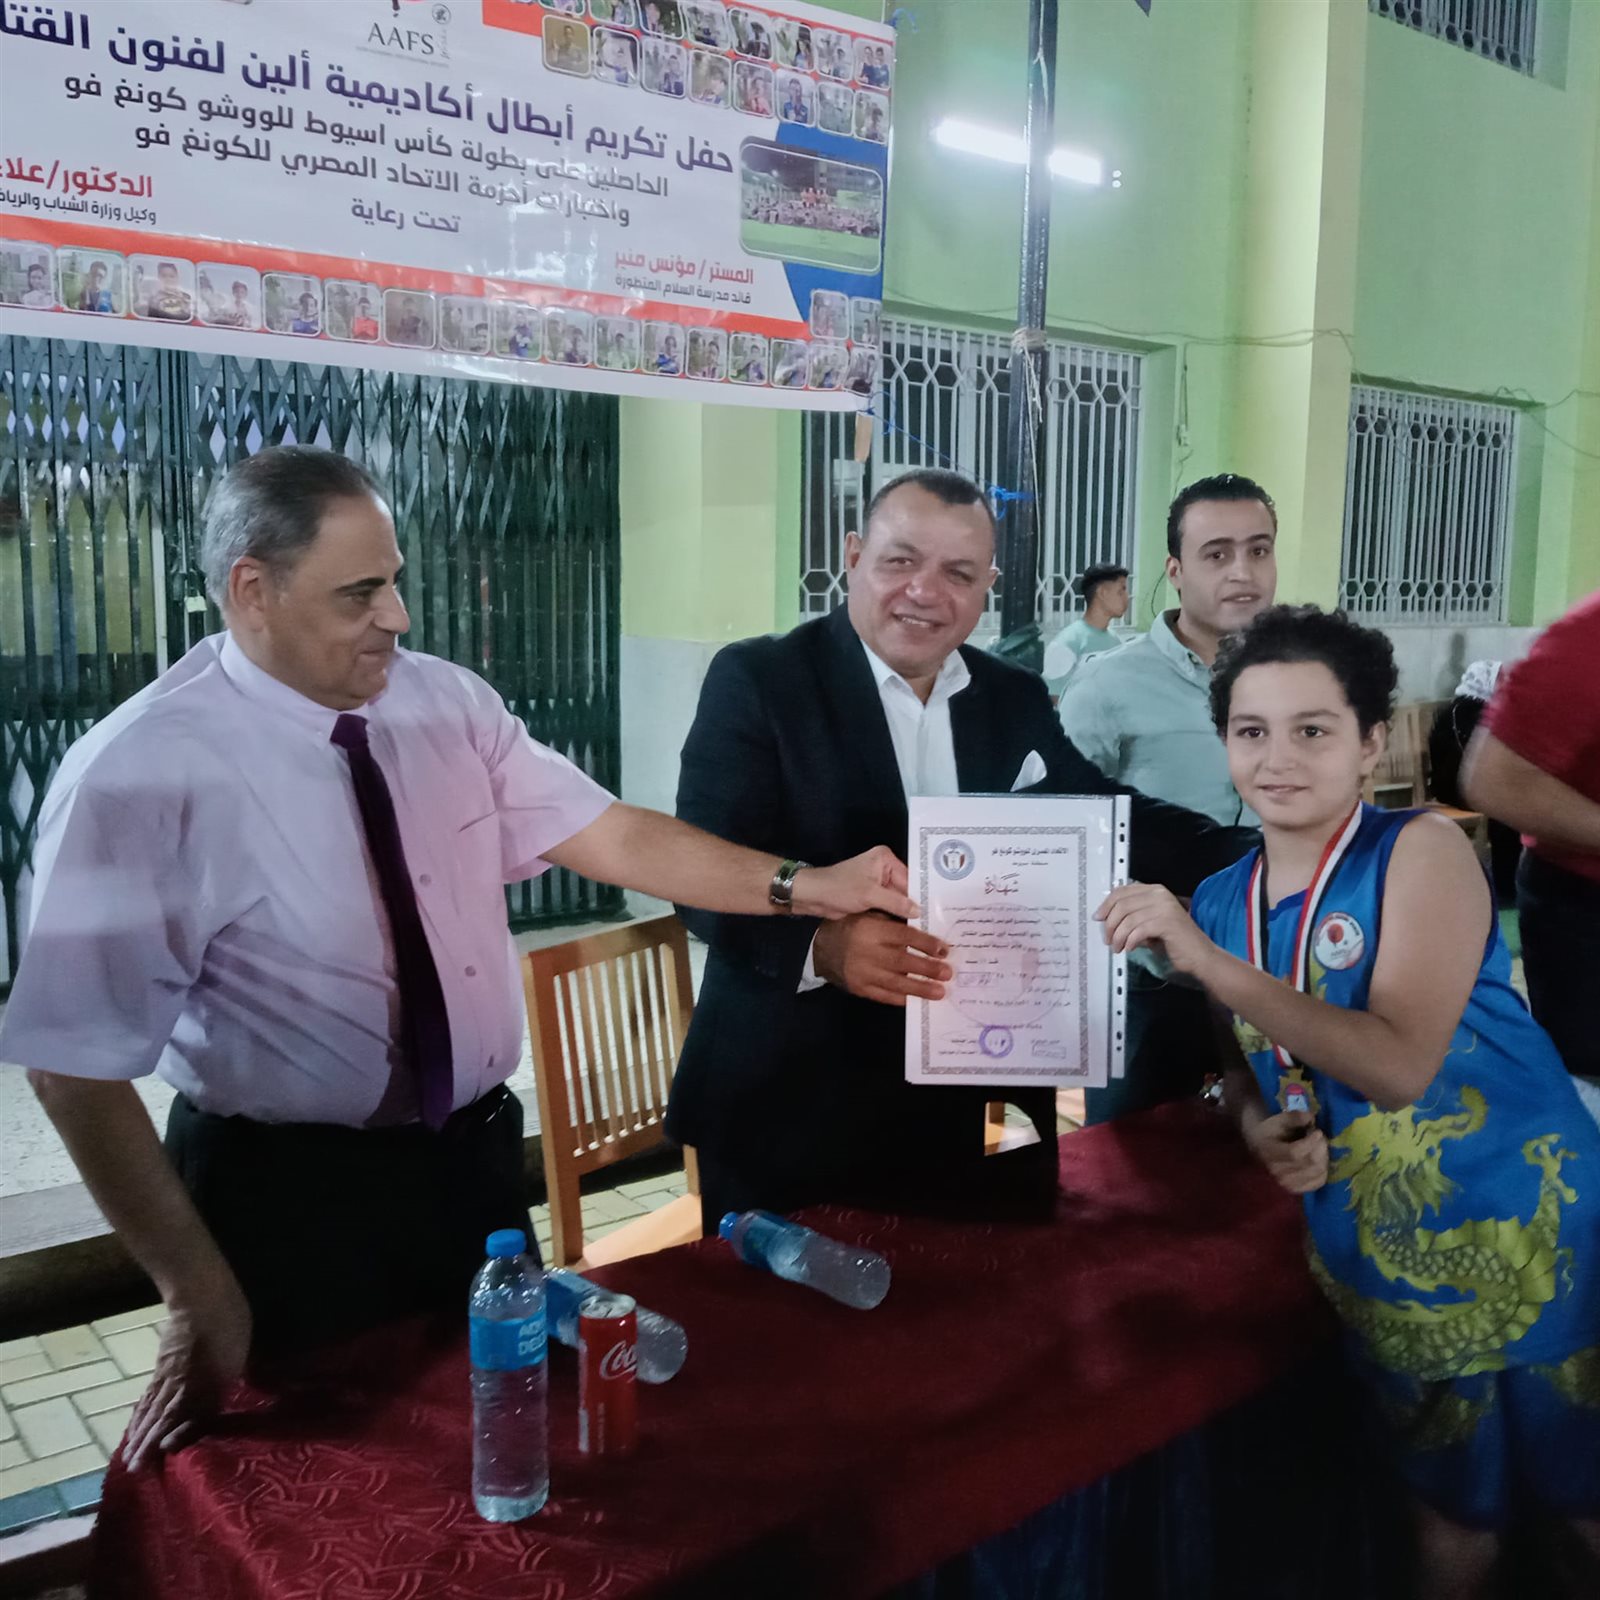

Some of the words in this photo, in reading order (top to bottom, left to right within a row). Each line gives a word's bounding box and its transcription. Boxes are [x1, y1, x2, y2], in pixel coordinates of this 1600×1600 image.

[0, 0, 90, 49] القتا
[367, 22, 434, 55] AAFS
[108, 27, 225, 73] لفنون
[64, 73, 102, 99] فو
[241, 50, 310, 94] ألين
[114, 79, 186, 113] كونغ
[325, 64, 473, 120] أكاديمية
[198, 94, 294, 131] للووشو
[304, 110, 385, 146] اسيوط
[487, 98, 573, 146] أبطال
[135, 123, 170, 149] فو
[182, 128, 271, 161] للكونغ
[395, 127, 453, 156] كأس
[585, 126, 667, 159] تكريم
[280, 153, 377, 179] المصري
[461, 140, 526, 176] بطولة
[535, 157, 587, 180] على
[676, 136, 733, 173] حفل
[386, 163, 459, 193] الاتحاد
[587, 164, 668, 196] الحاصلين
[43, 195, 88, 214] الشباب
[91, 201, 121, 219] وزارة
[124, 207, 156, 225] وكيل
[351, 198, 404, 230] رعاية
[536, 190, 629, 227] واختبارات
[413, 211, 461, 233] تحت
[614, 249, 645, 270] منير
[649, 255, 696, 278] مؤنس
[709, 262, 754, 284] المستر
[615, 274, 662, 291] المتطورة
[663, 283, 695, 297] السلام
[696, 286, 729, 302] مدرسة
